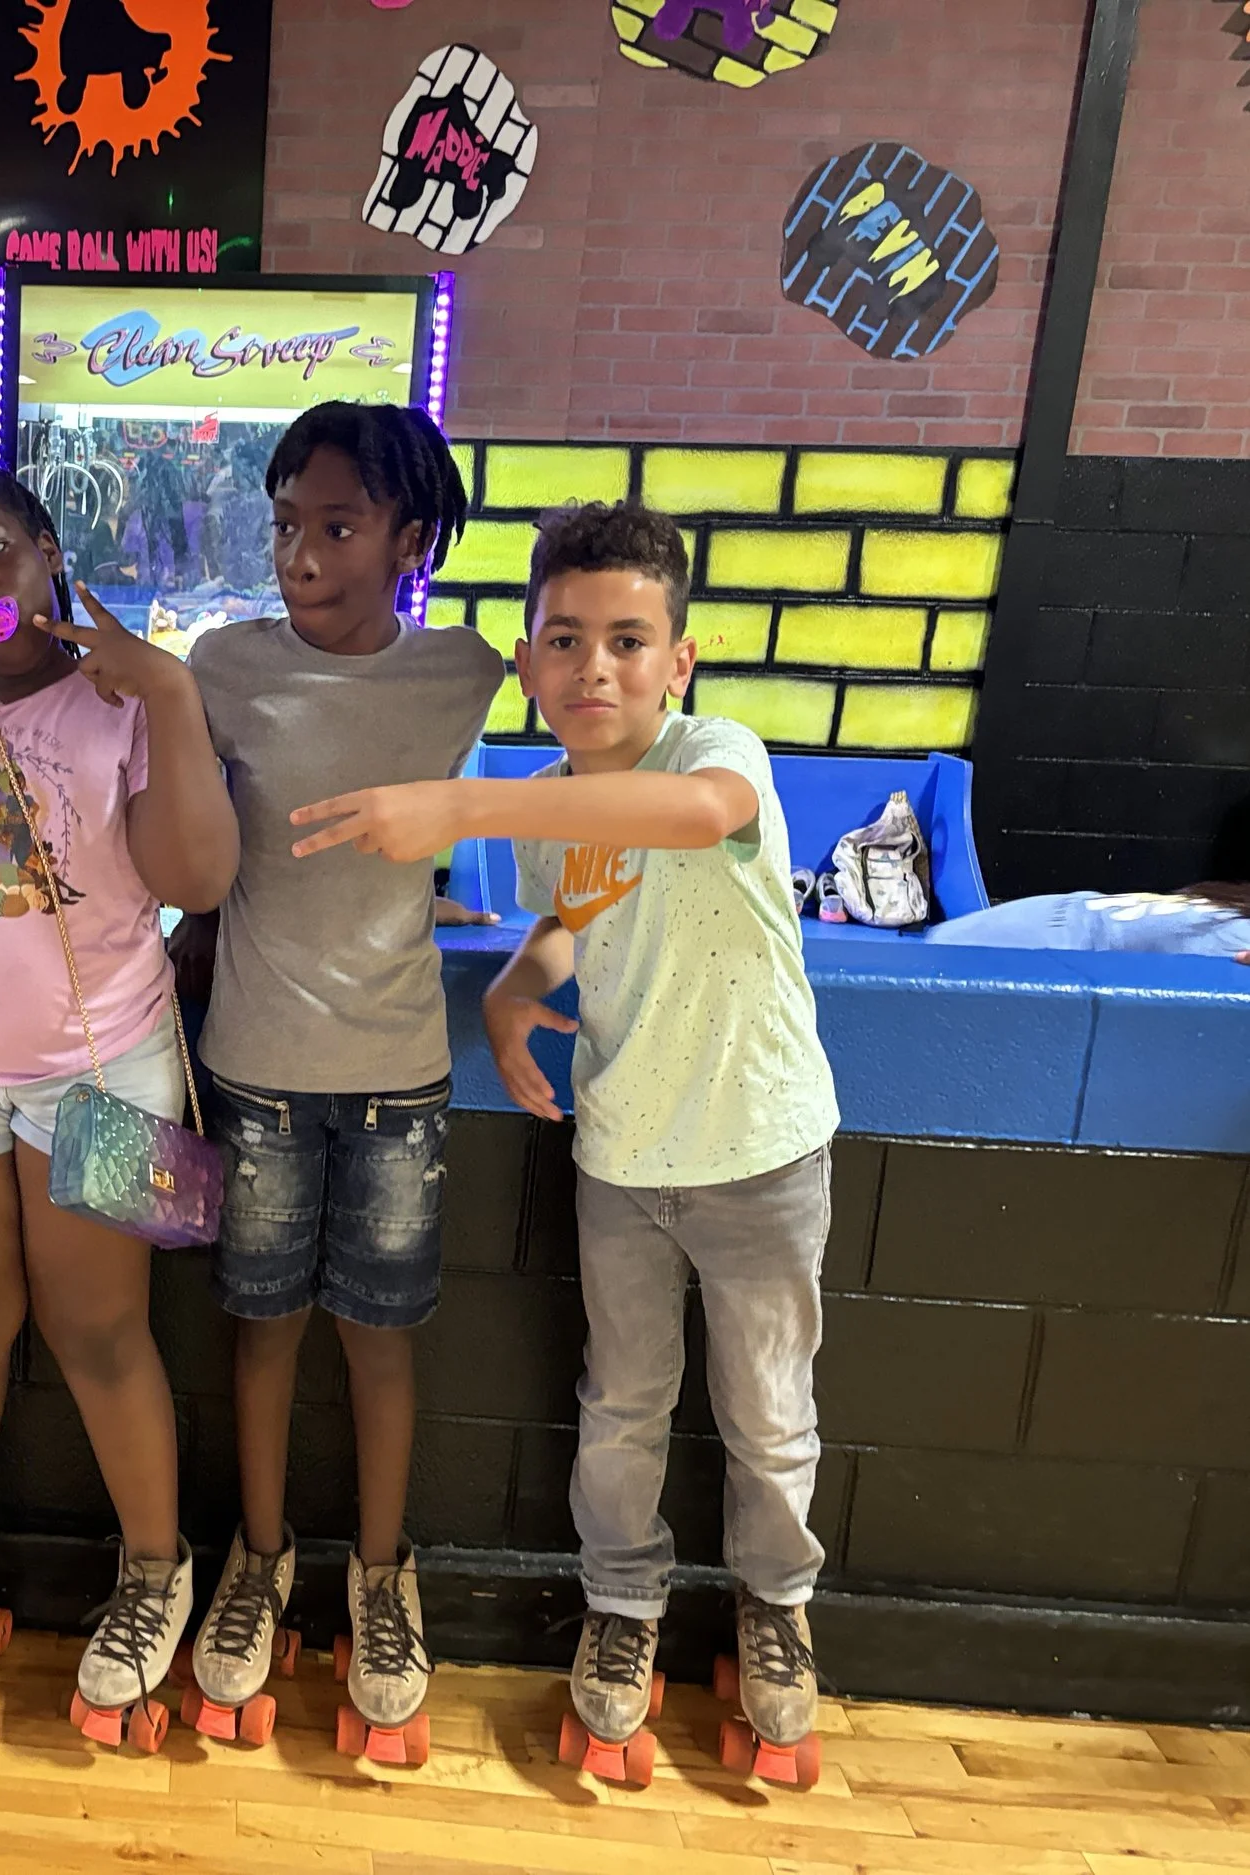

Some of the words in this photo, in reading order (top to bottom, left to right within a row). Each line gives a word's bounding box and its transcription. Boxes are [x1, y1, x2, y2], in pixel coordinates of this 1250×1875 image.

[6, 229, 61, 270] COME
[67, 229, 120, 271] ROLL
[126, 229, 181, 273] WITH
[187, 227, 218, 274] US!
[838, 182, 940, 304] DEVIN
[87, 325, 200, 375] Clean
[192, 325, 340, 380] Sweep
[563, 846, 628, 896] NIKE
